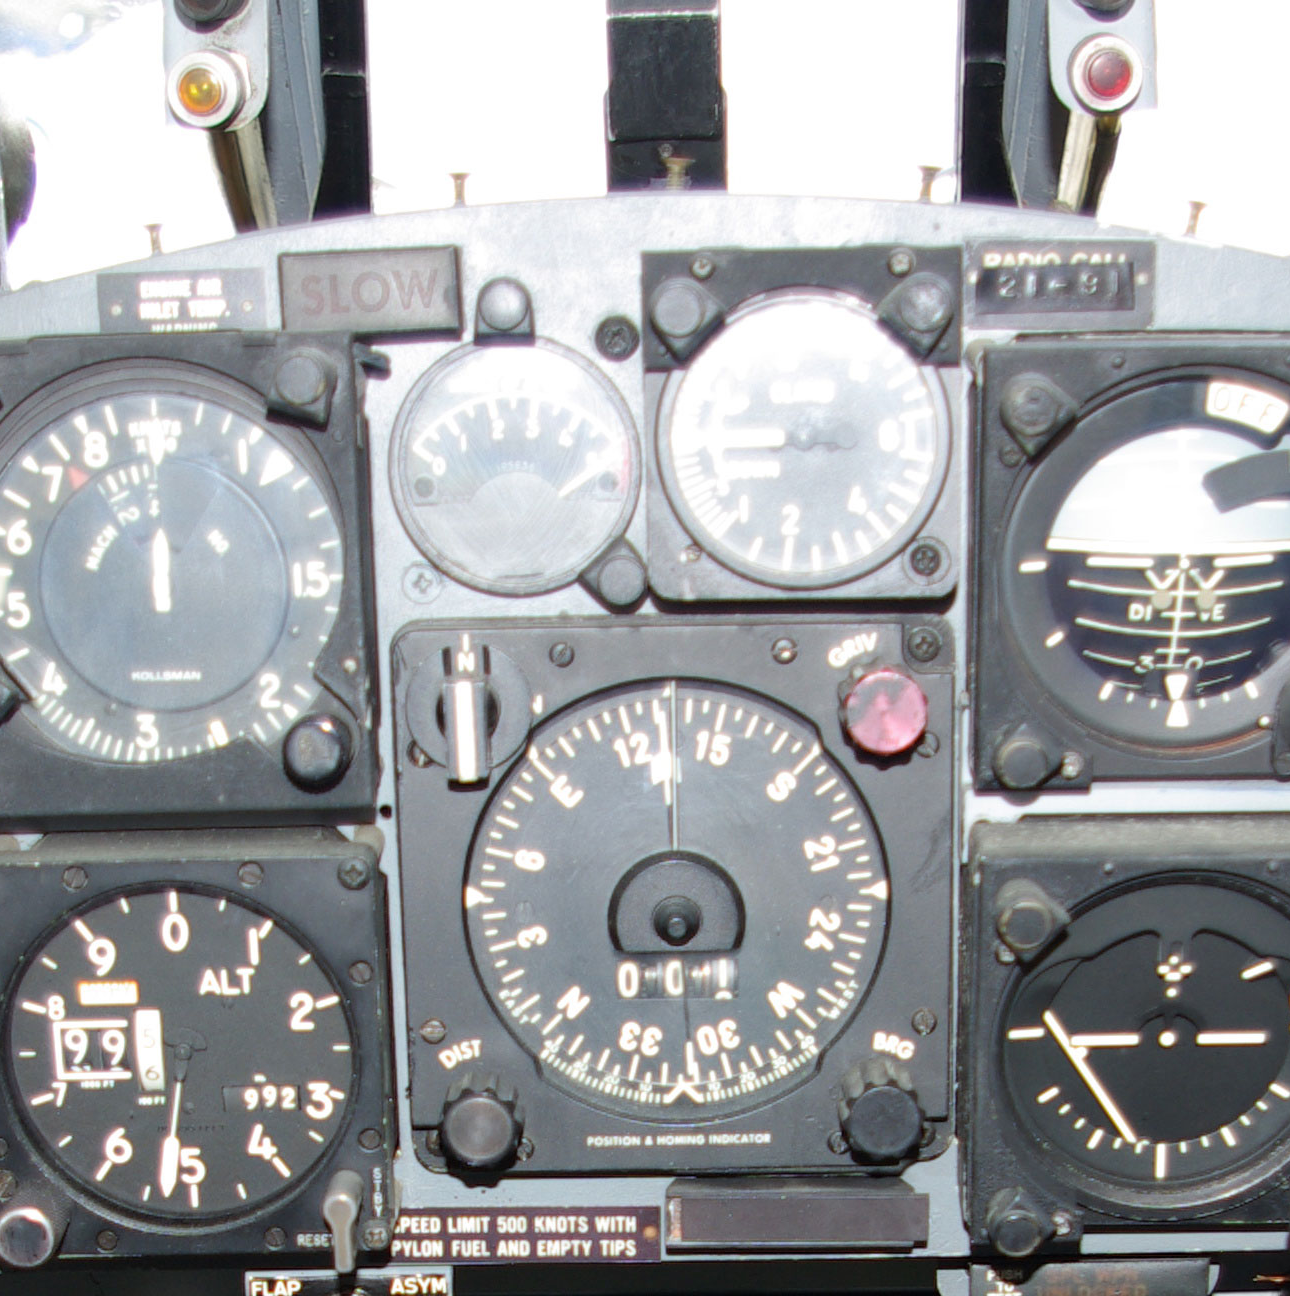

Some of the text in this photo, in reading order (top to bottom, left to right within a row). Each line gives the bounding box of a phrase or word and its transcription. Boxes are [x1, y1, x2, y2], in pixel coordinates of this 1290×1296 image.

[302, 271, 440, 318] SLOW
[132, 670, 200, 682] KOLLSMAN
[199, 968, 255, 996] ALT
[872, 1032, 916, 1060] BRG
[587, 1133, 771, 1147] POSITION & HOMING INDICATOR
[394, 1214, 637, 1235] PEED LIMIT 500 KNOTS WITH
[391, 1239, 637, 1258] PYLON FUEL AND EMPTY TIPS
[391, 1278, 447, 1296] ASYM
